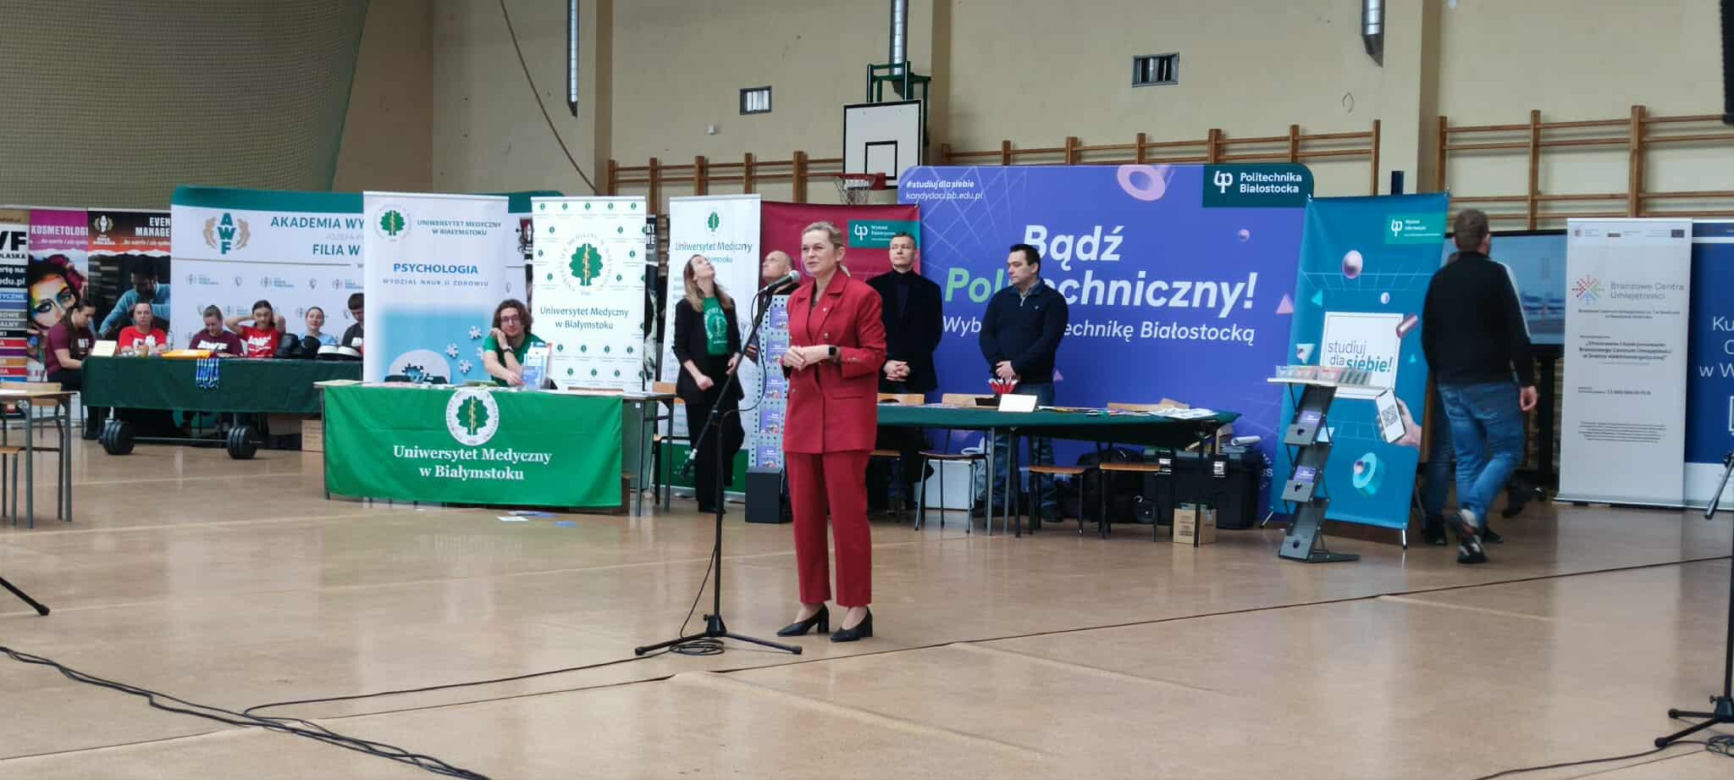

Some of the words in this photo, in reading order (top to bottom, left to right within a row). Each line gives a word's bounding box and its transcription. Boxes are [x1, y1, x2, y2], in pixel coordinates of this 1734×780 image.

[1240, 172, 1302, 182] Politechnika
[1240, 183, 1299, 193] Białostocka
[270, 216, 341, 229] AKADEMIA
[312, 244, 344, 255] FILIA
[348, 245, 360, 255] W
[675, 241, 716, 252] Uniwersytet
[717, 241, 753, 253] Medyczny
[1024, 224, 1125, 271] Bądź
[393, 263, 479, 274] PSYCHOLOGIA
[540, 306, 589, 317] Uniwersytet
[590, 307, 629, 319] Medyczny
[564, 320, 614, 331] Białymstoku
[1140, 321, 1255, 346] Białostocką
[1328, 340, 1367, 358] studiuj
[1330, 355, 1345, 366] dla
[1346, 355, 1393, 372] siebie!
[1699, 366, 1714, 377] w
[393, 445, 478, 462] Uniwersytet
[481, 448, 552, 465] Medyczny
[419, 467, 432, 477] w
[435, 464, 525, 481] Białymstoku
